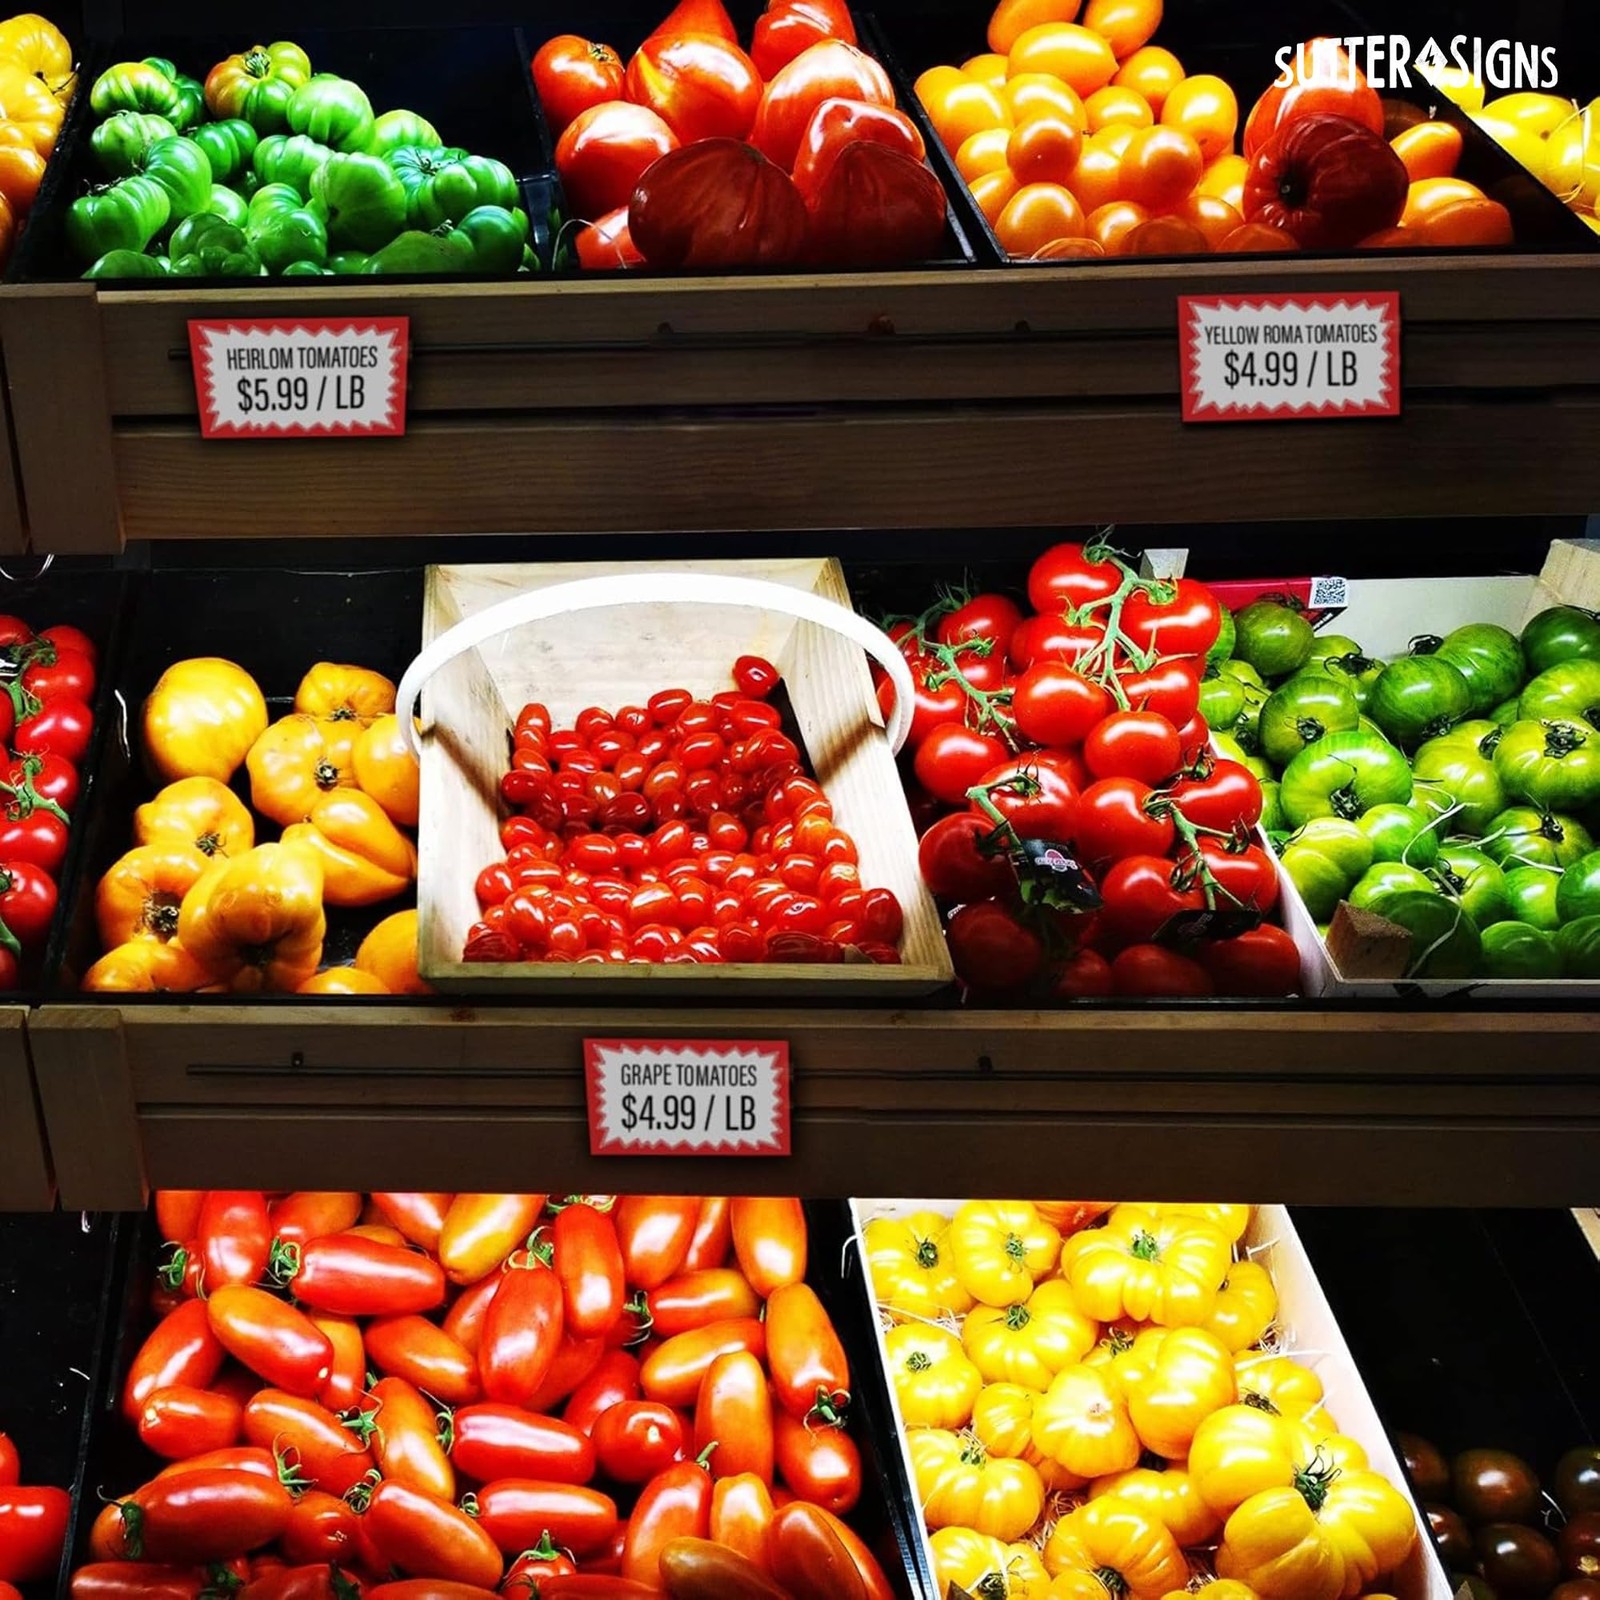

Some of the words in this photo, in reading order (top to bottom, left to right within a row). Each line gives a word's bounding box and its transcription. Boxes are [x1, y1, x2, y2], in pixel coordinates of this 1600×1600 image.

[1205, 326, 1259, 345] YELLOW
[1264, 325, 1303, 343] ROMA
[1305, 324, 1377, 343] TOMATOES
[227, 348, 293, 370] HEIRLOM
[298, 346, 378, 368] TOMATOES
[1224, 349, 1298, 389] $4.99
[1307, 351, 1318, 387] /
[1327, 351, 1357, 386] LB
[237, 376, 308, 414] $5.99
[317, 376, 327, 411] /
[336, 375, 365, 409] LB
[621, 1064, 671, 1085] GRAPE
[677, 1064, 757, 1086] TOMATOES
[622, 1092, 695, 1132] $4.99
[704, 1095, 715, 1131] /
[726, 1095, 756, 1130] LB
